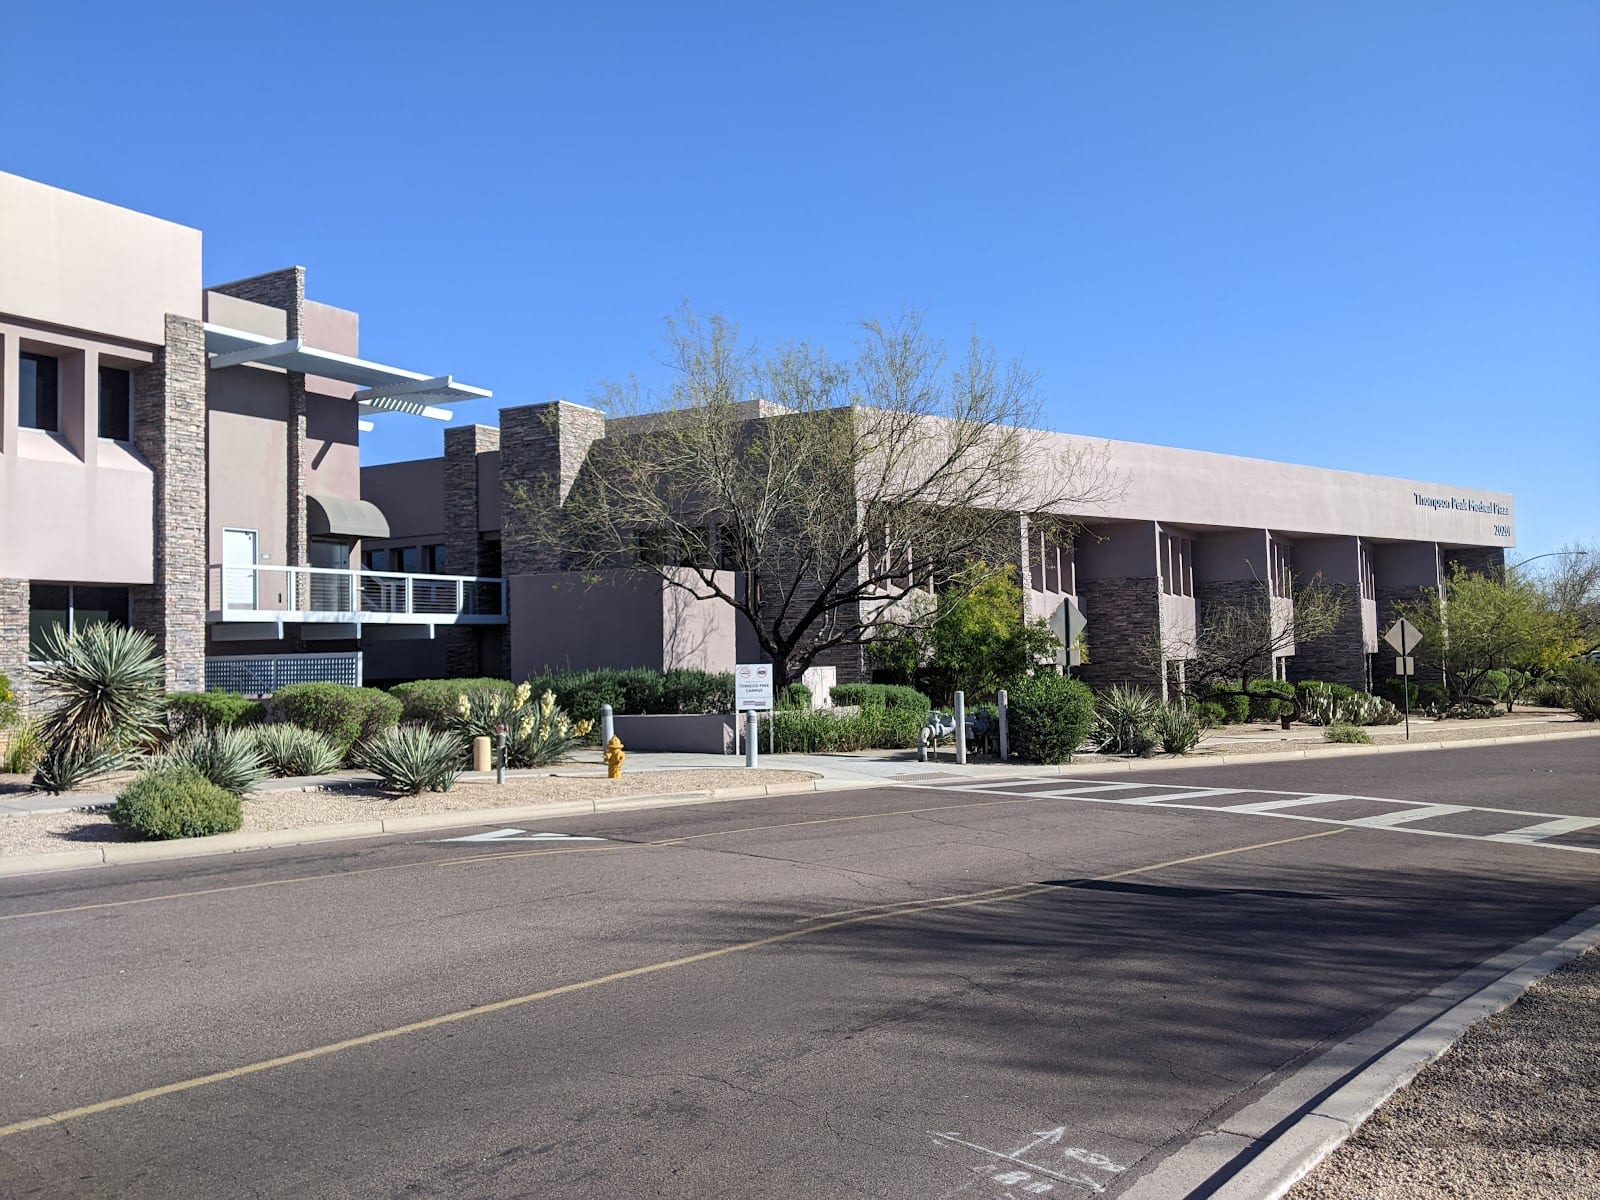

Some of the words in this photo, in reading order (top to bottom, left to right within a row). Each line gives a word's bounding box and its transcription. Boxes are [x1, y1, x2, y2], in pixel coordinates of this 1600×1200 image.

[1413, 492, 1450, 510] Thompson
[1451, 496, 1468, 511] Peak
[1469, 498, 1493, 514] Medical
[1494, 502, 1510, 515] Plaza
